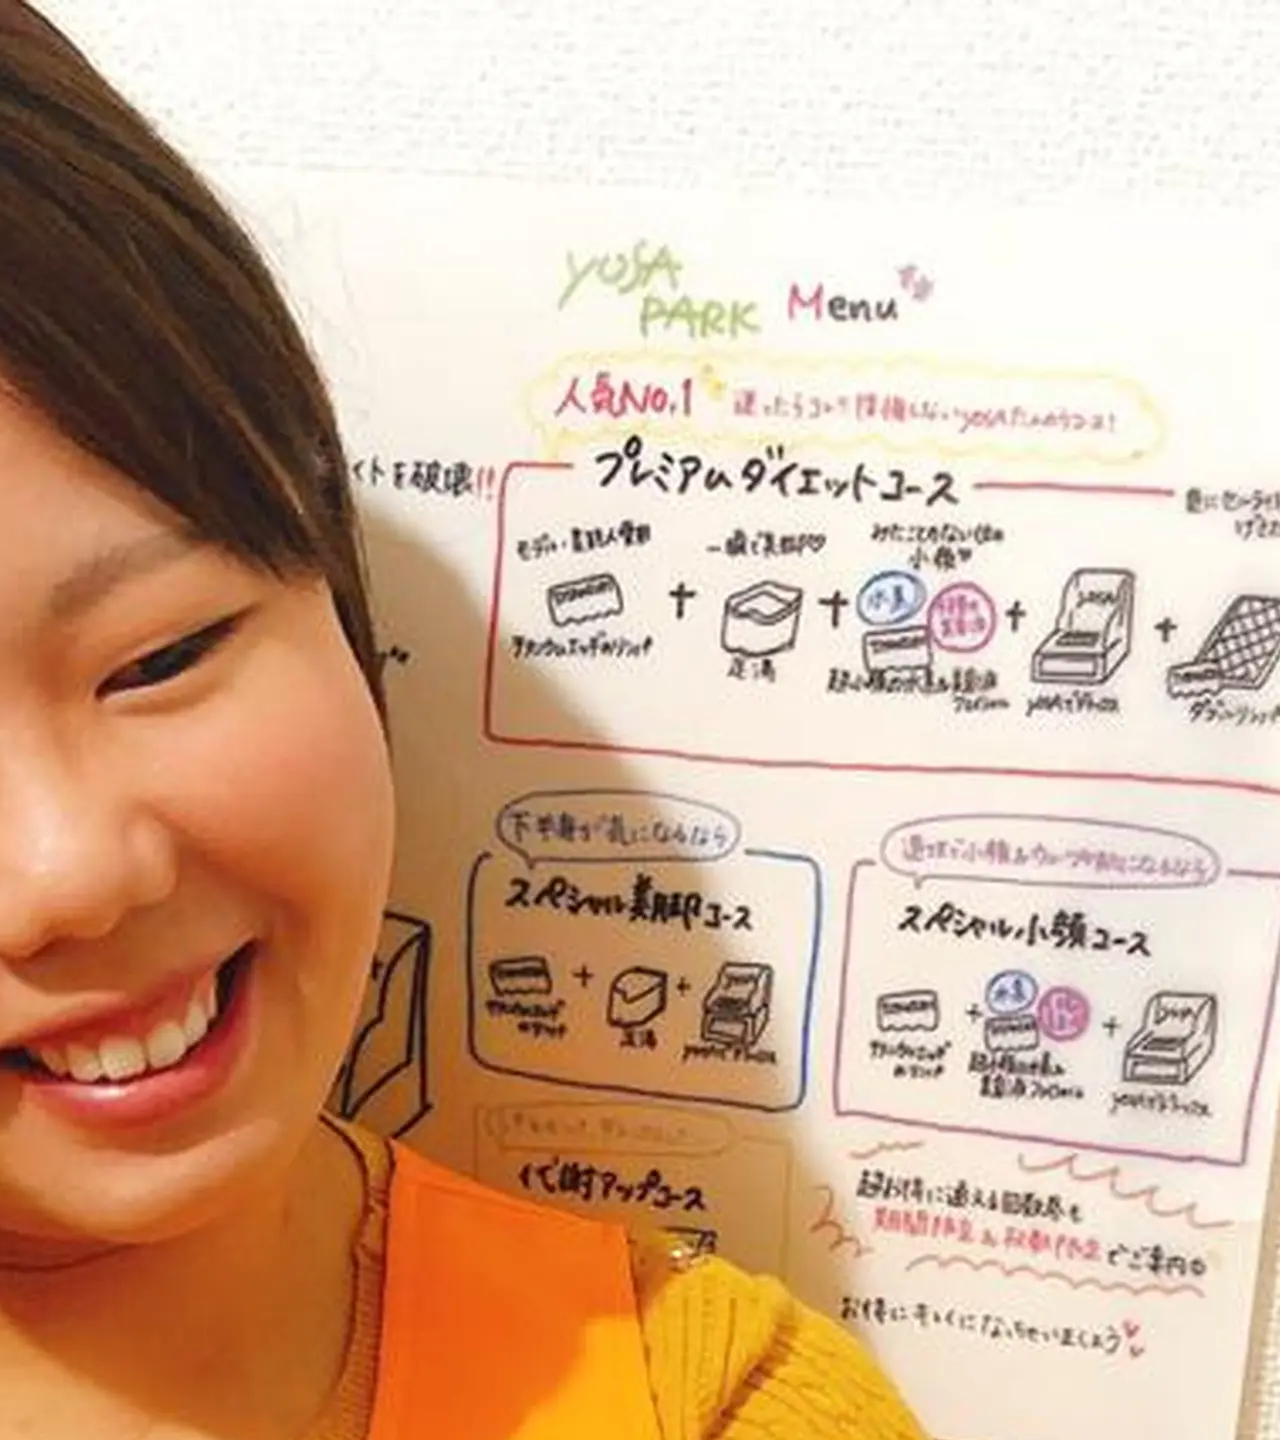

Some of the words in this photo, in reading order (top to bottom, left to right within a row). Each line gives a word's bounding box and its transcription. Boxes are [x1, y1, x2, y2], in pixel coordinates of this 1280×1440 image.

[638, 296, 760, 338] PARK
[787, 282, 899, 323] Menu
[554, 371, 693, 418] 人気No.1
[593, 434, 960, 506] プレミアムダイエットコース
[504, 872, 755, 931] スペシャル美脚コース
[898, 900, 1152, 957] スペシャル小顔コース
